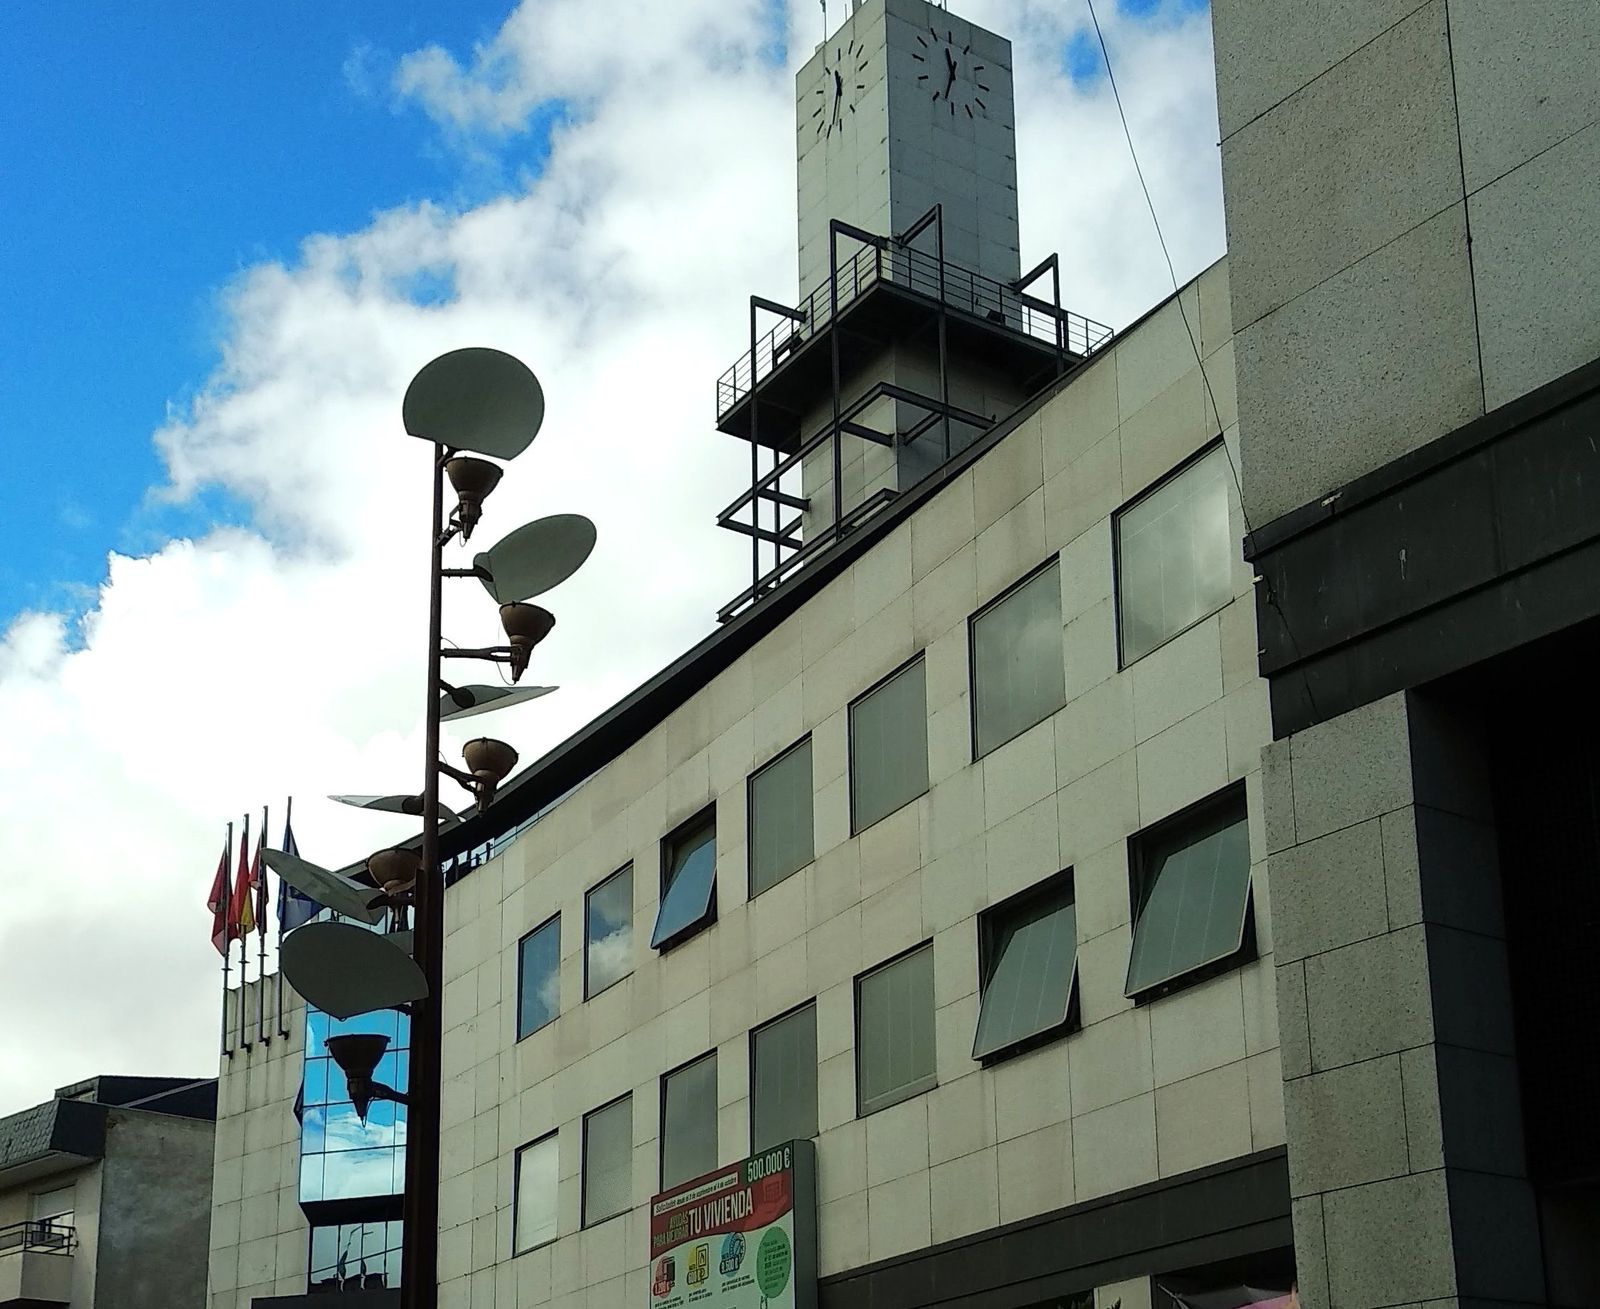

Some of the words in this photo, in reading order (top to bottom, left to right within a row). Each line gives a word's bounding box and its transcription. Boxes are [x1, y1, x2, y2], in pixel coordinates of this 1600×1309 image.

[747, 1151, 782, 1183] 500.000
[784, 1147, 790, 1169] €
[688, 1206, 702, 1236] TU
[703, 1186, 753, 1231] VIVIENDA
